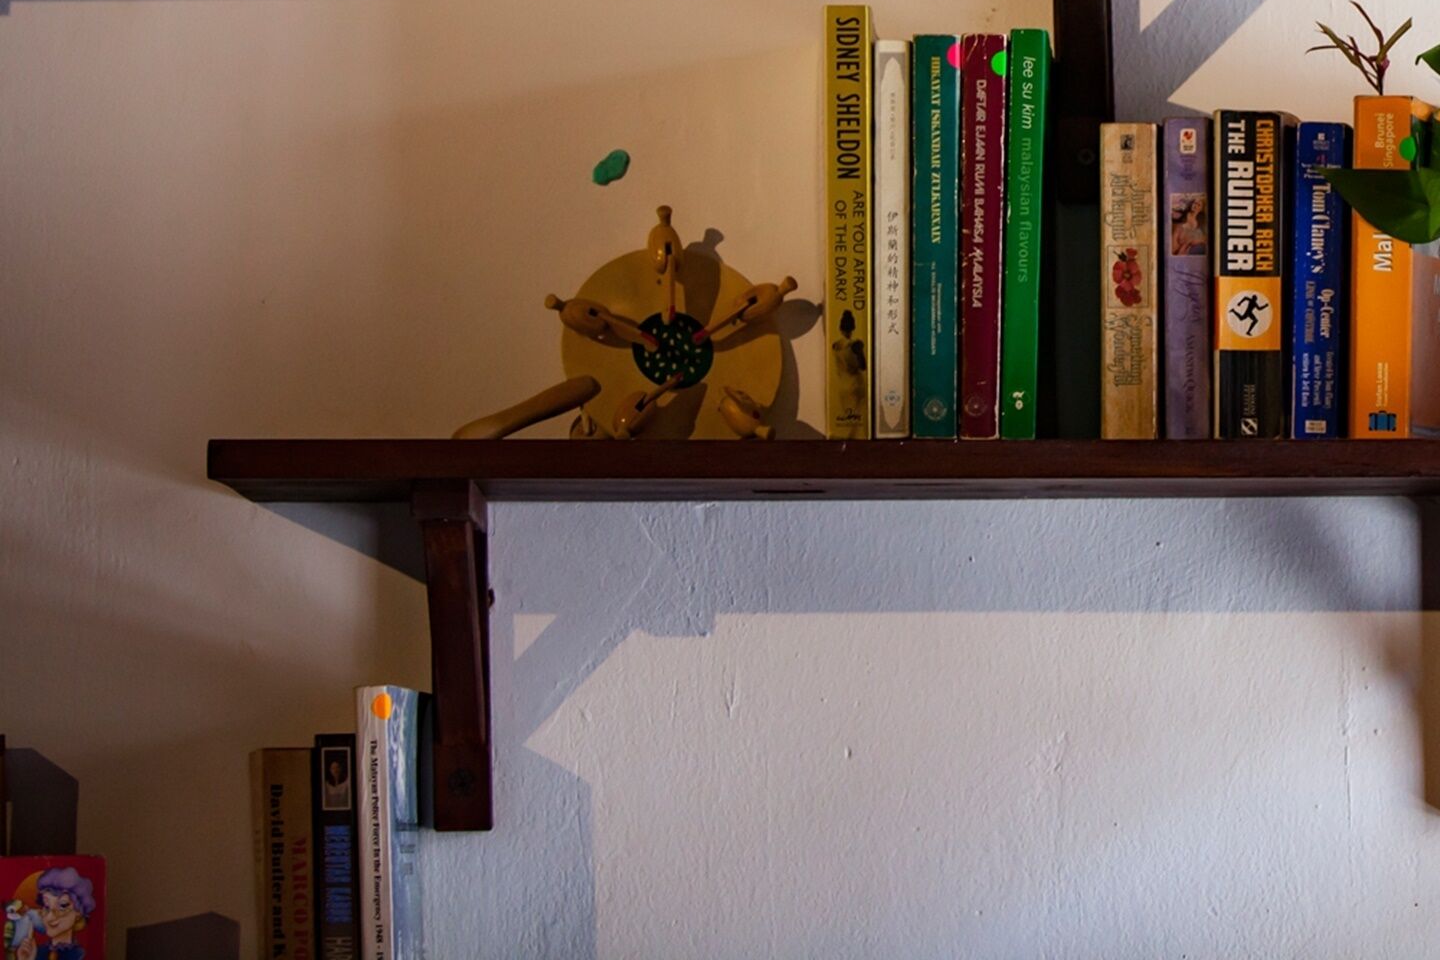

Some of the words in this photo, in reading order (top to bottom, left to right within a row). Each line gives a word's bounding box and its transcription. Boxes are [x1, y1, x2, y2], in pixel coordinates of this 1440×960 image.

[836, 17, 861, 82] SIDNEY
[1022, 55, 1036, 78] lee
[930, 55, 942, 106] HIKAYAT
[975, 79, 987, 122] DAFTAR
[1022, 81, 1035, 100] su
[836, 93, 861, 179] SHELDON
[930, 108, 942, 169] ISKANDAR
[1021, 103, 1036, 130] kim
[1227, 119, 1246, 154] THE
[1374, 112, 1386, 149] Brunei
[1383, 112, 1396, 168] Singapore
[974, 163, 986, 195] RUMI
[1017, 137, 1034, 216] malaysian
[1255, 119, 1275, 224] CHRISTOPHER
[835, 199, 848, 219] OF
[852, 190, 865, 218] ARE
[929, 171, 941, 245] ZULKARNAIN
[973, 197, 985, 242] BAHASA
[1226, 160, 1254, 271] RUNNER
[1311, 182, 1332, 213] Tom
[835, 223, 848, 253] THE
[852, 221, 865, 254] YOU
[1017, 220, 1032, 284] flavours
[1255, 228, 1275, 271] REICH
[1306, 214, 1332, 274] Clancy's
[835, 256, 848, 302] DARK?
[852, 258, 867, 311] AFRAID
[971, 246, 985, 308] MALAYSIA
[1316, 288, 1335, 339] Op-Center
[270, 784, 284, 838] David
[371, 796, 379, 821] Police
[372, 822, 380, 846] Force
[271, 842, 285, 902] Butler
[292, 838, 309, 924] MARCO
[373, 859, 381, 873] the
[372, 875, 382, 921] Emergency
[272, 906, 286, 939] and
